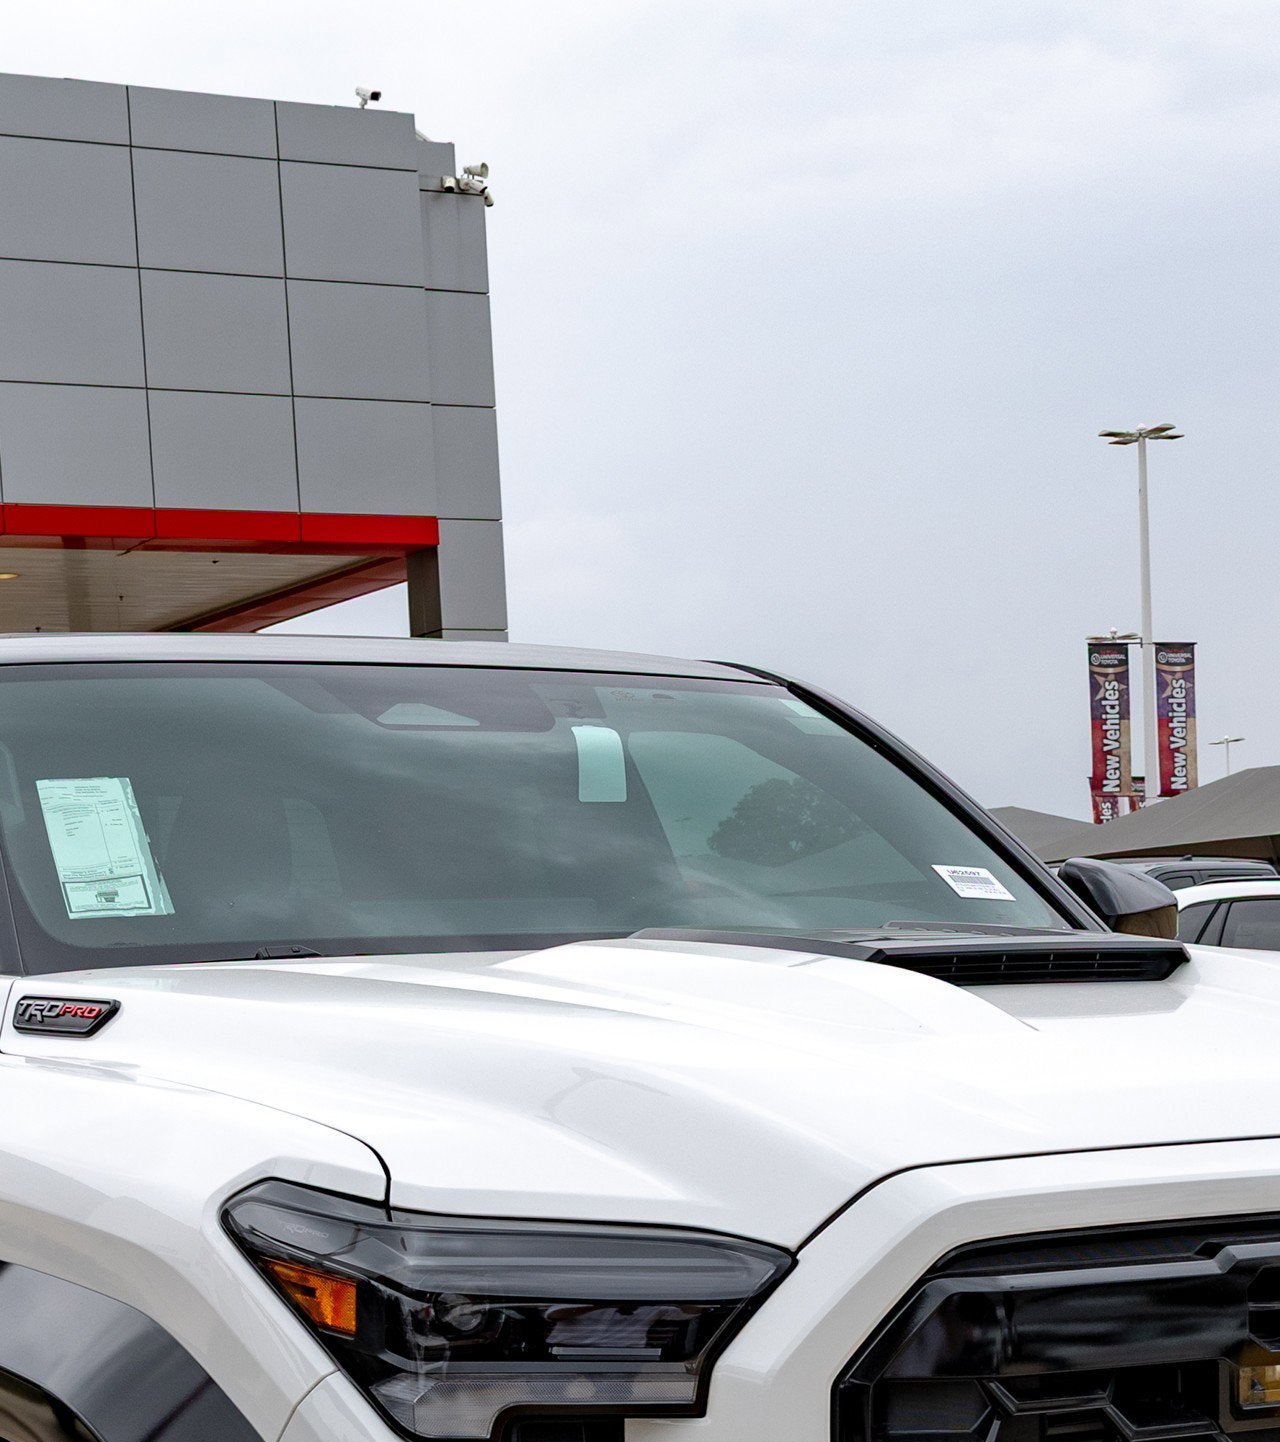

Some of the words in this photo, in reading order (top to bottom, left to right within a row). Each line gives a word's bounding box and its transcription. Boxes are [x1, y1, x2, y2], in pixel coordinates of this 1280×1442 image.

[1102, 680, 1120, 751] Vehicles
[1169, 679, 1188, 749] Vehicles
[1102, 754, 1120, 792] New
[1170, 752, 1188, 790] New
[19, 1000, 64, 1023] TRD
[60, 1004, 102, 1019] PRO
